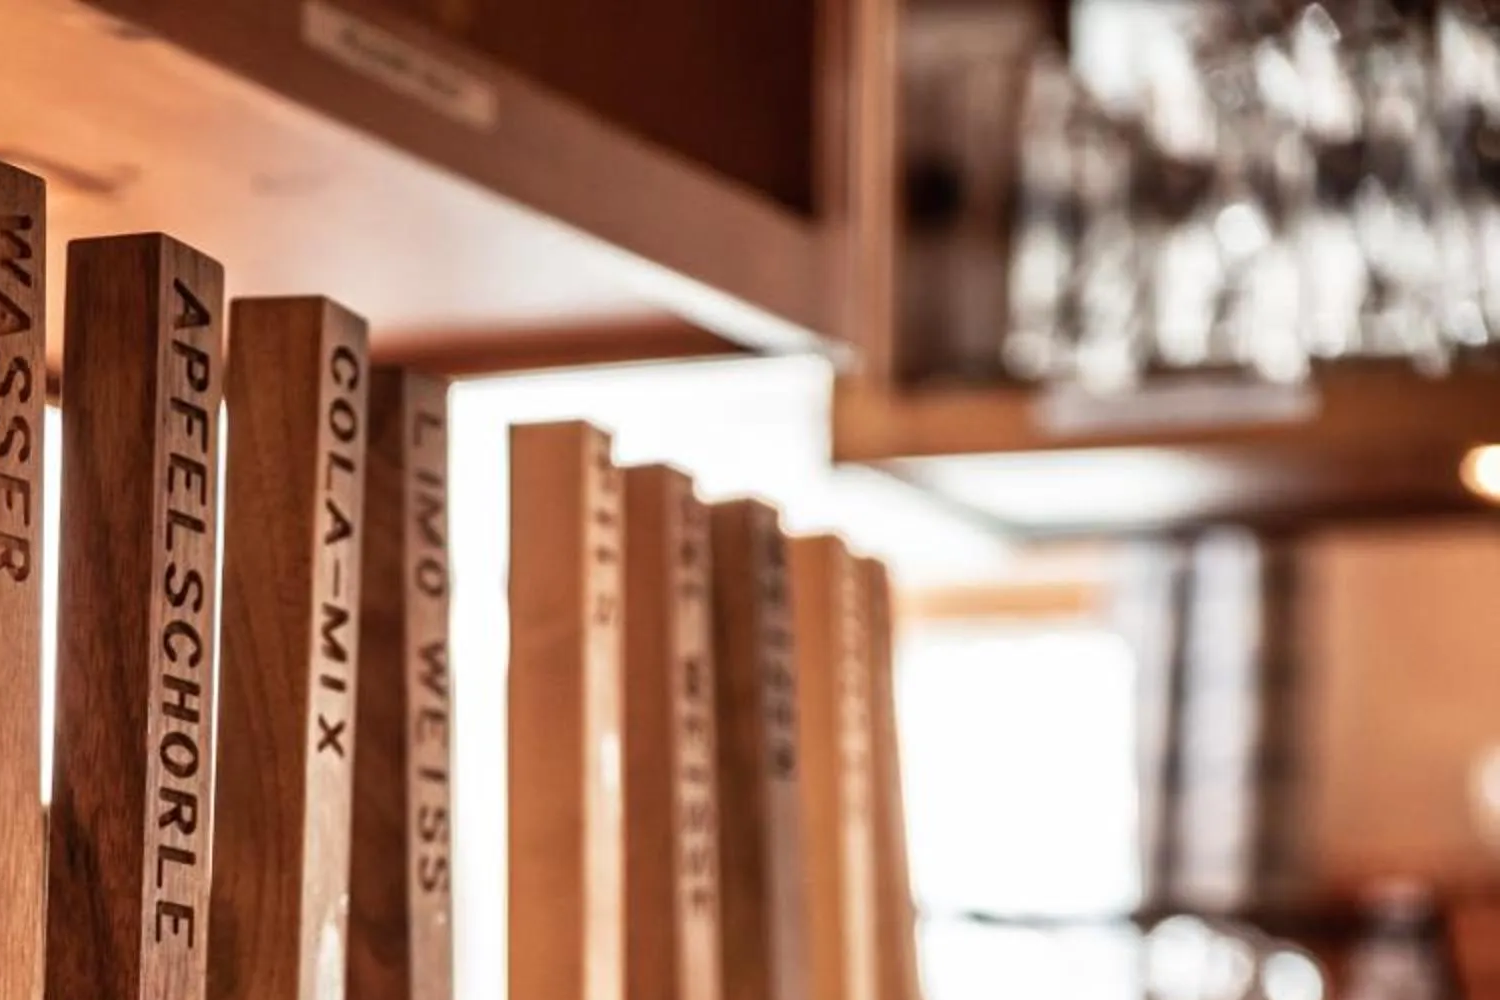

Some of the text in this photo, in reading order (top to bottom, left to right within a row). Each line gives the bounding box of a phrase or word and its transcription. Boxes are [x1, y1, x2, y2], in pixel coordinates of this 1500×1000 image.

[154, 277, 211, 949] APFELSCHORLE
[317, 345, 359, 758] COLA-MIX
[412, 411, 447, 894] LIMO WEISS
